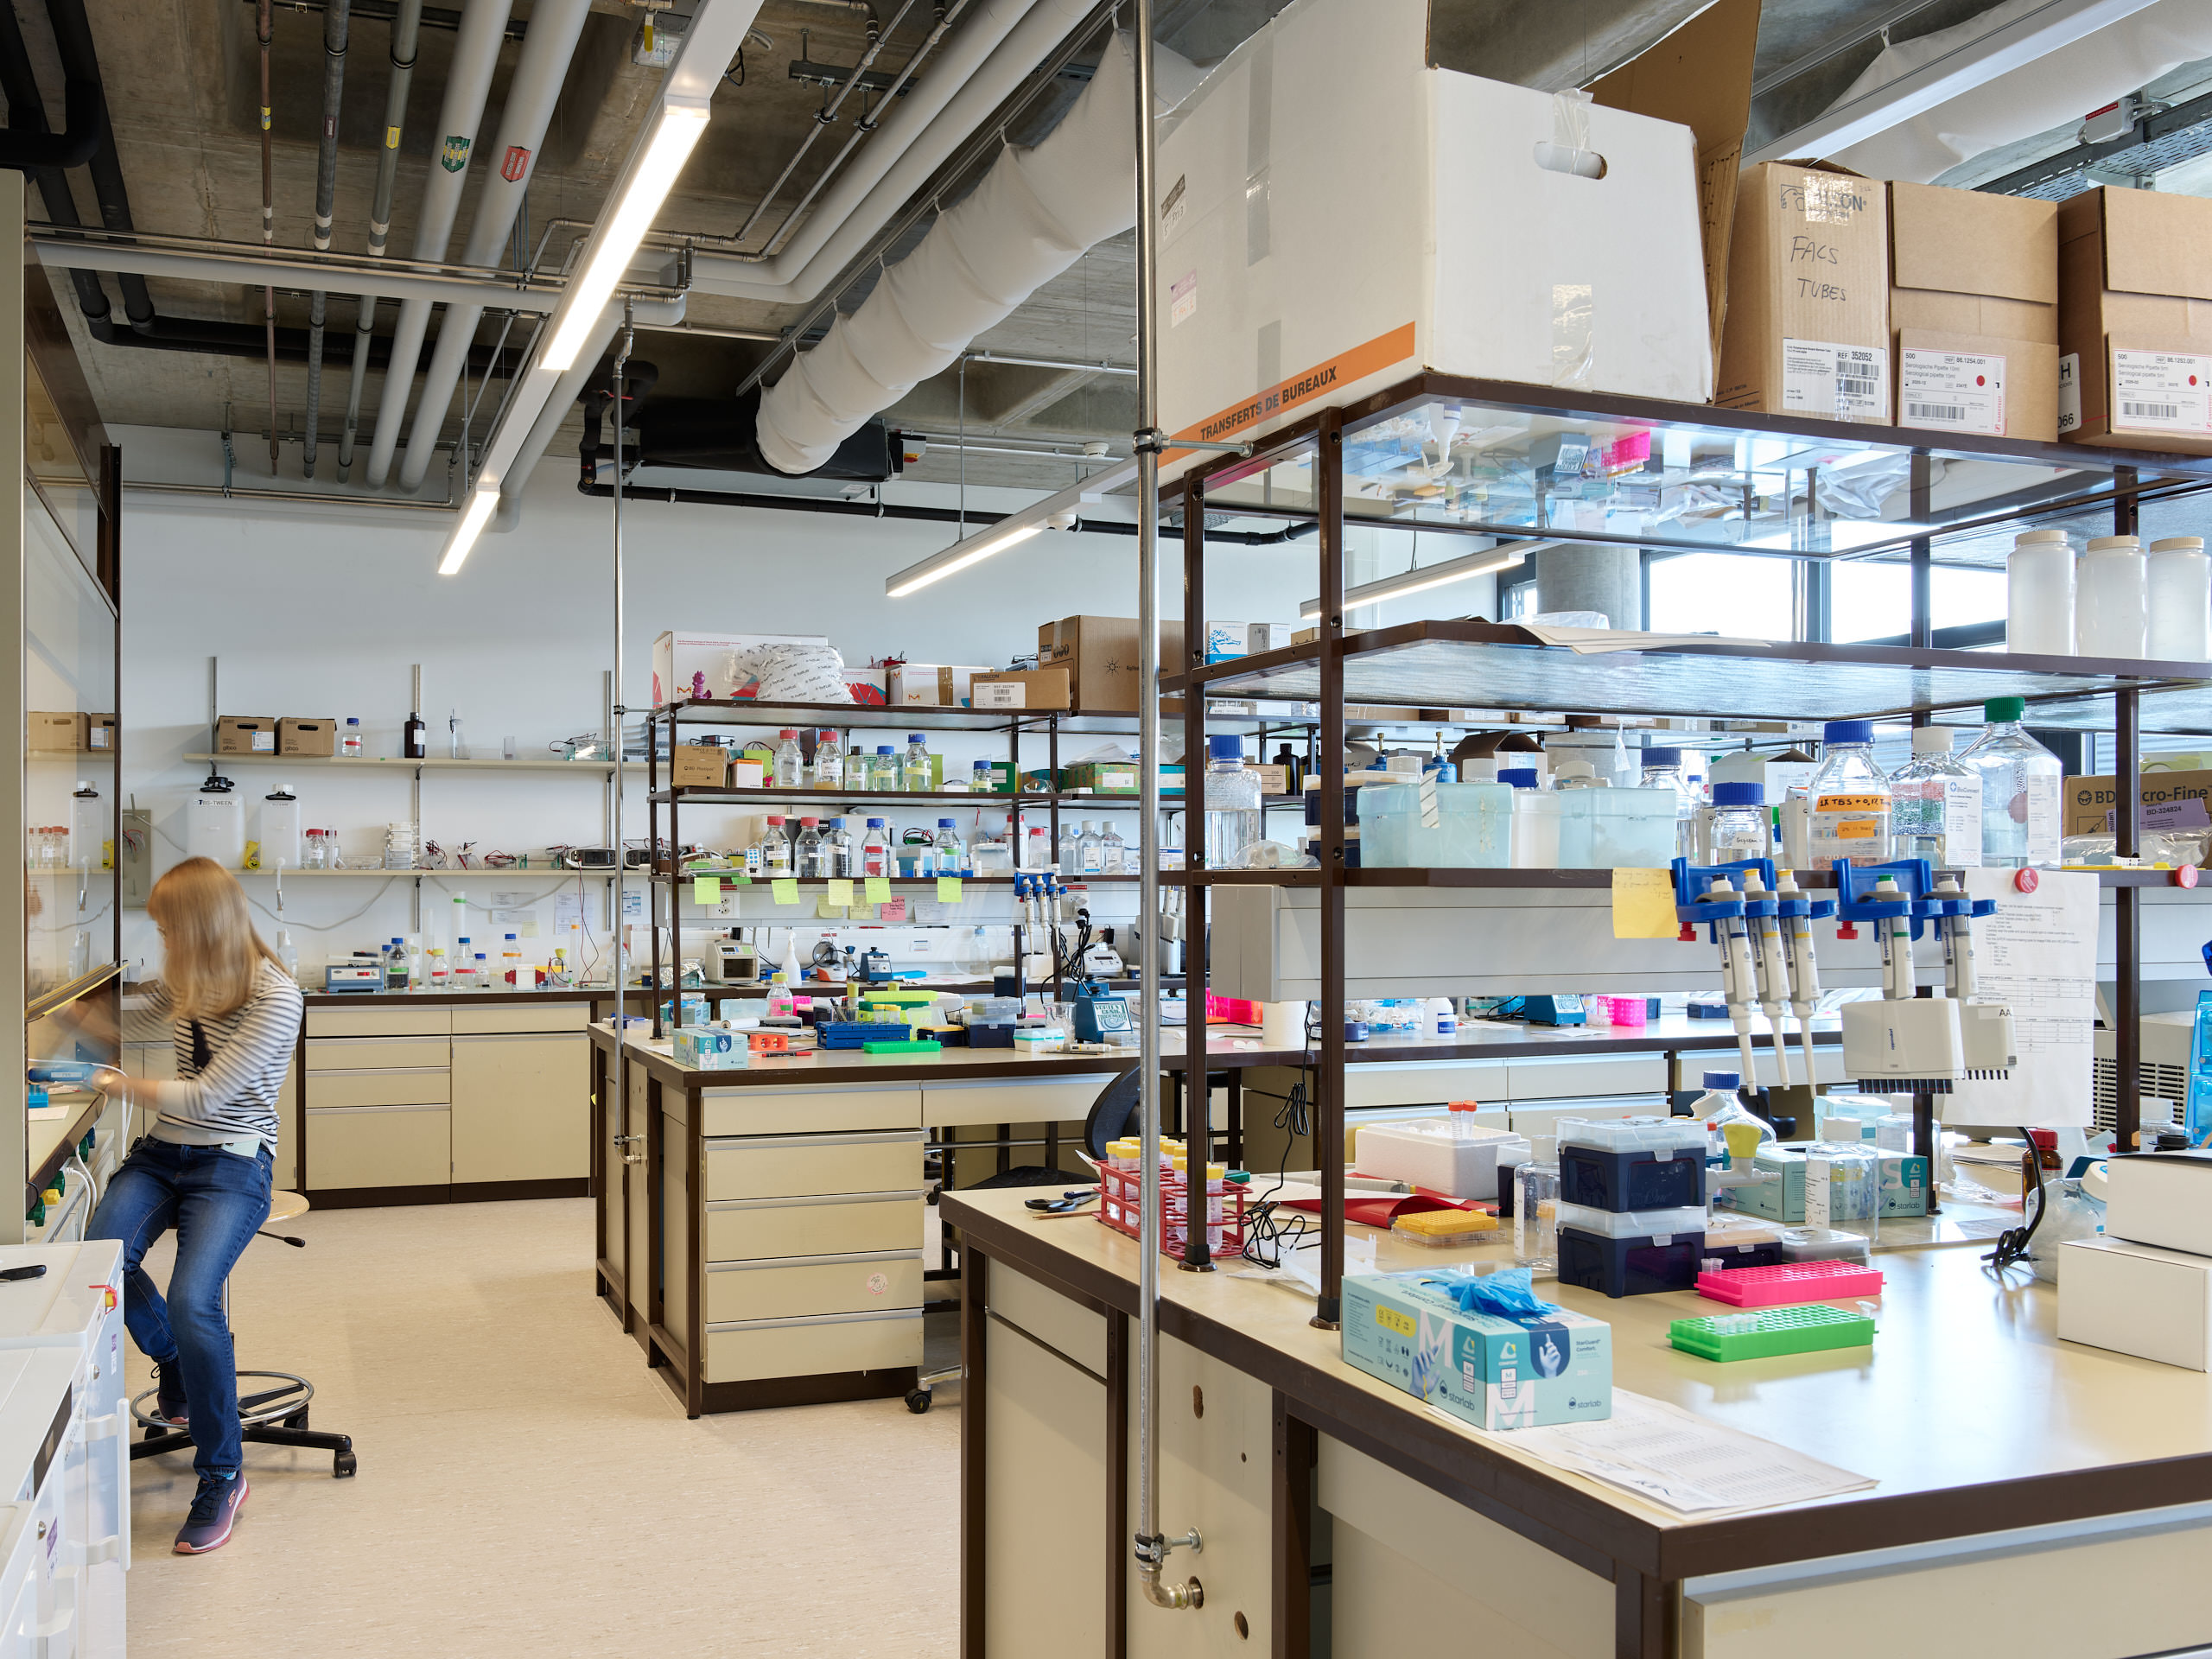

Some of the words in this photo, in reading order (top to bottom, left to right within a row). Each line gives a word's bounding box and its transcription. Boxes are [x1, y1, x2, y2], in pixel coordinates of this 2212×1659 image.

[1790, 236, 1839, 264] FACS
[1797, 278, 1847, 302] TUBES
[1851, 351, 1872, 361] 352052
[1200, 402, 1262, 441] TRANSFERTS
[1265, 392, 1280, 412] DE
[1282, 366, 1338, 404] BUREAUX
[2094, 791, 2115, 804] BD
[2139, 785, 2209, 804] cro-Fine
[2146, 805, 2183, 816] BD-324824
[1719, 934, 1728, 960] eppendorf
[1752, 933, 1761, 960] eppendorf
[1999, 1008, 2012, 1017] AA
[1897, 1201, 1920, 1210] starlab
[1448, 1392, 1475, 1411] starlab
[1577, 1399, 1602, 1409] starlab
